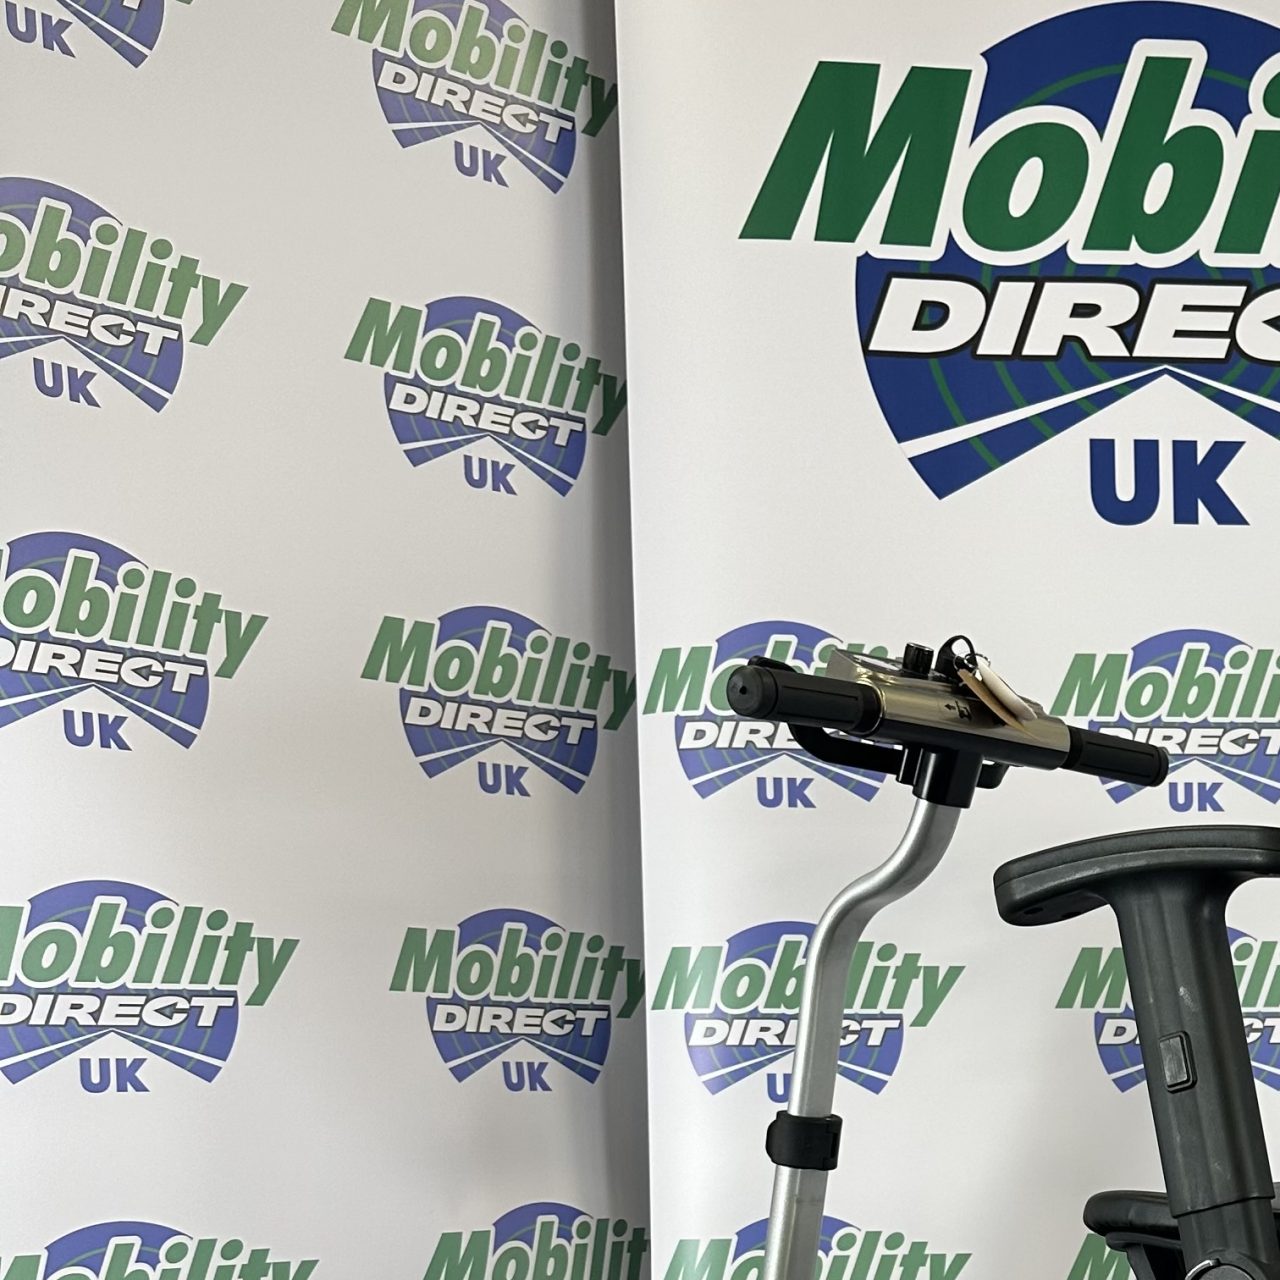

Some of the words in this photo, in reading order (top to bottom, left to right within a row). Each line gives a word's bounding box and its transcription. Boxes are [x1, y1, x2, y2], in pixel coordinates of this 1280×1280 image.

[5, 0, 76, 59] UK
[331, 0, 618, 138] Mobility
[377, 60, 573, 144] DIRECT
[454, 140, 509, 188] UK
[0, 204, 249, 346] bility
[0, 284, 180, 355] RECT
[33, 357, 101, 408] UK
[344, 297, 627, 436] Mobility
[388, 382, 583, 446] DIRECT
[463, 454, 518, 496] UK
[1088, 438, 1250, 526] UK
[0, 548, 269, 679] obility
[63, 709, 132, 751] UK
[404, 697, 595, 745] DIRECT
[477, 761, 531, 797] UK
[756, 777, 816, 808] UK
[1169, 782, 1225, 812] UK
[0, 902, 300, 1006] obility
[651, 940, 966, 1028] Moblity
[433, 1003, 608, 1036] DIRECT
[79, 1057, 150, 1093] UK
[502, 1061, 552, 1092] UK
[767, 1073, 793, 1103] U
